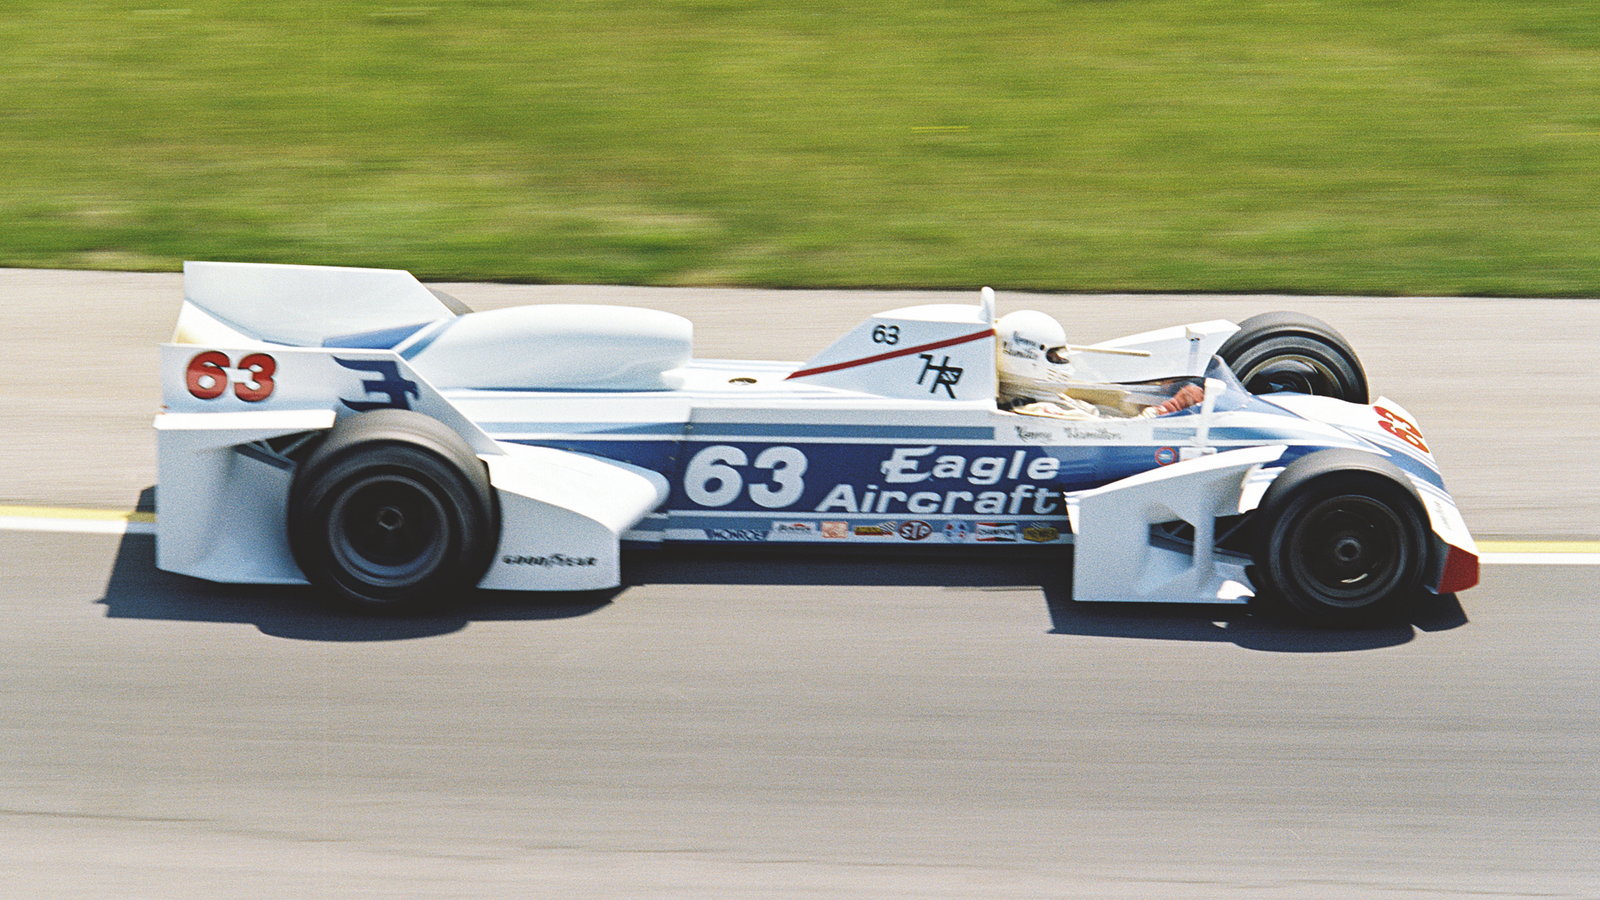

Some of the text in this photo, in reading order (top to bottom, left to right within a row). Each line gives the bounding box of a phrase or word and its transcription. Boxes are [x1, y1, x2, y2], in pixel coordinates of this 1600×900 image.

[872, 324, 899, 345] 63
[185, 350, 276, 402] 63
[1373, 405, 1431, 454] 63
[683, 445, 808, 508] 63
[880, 445, 1061, 485] Eagle
[814, 484, 1061, 514] Aircraft
[900, 522, 931, 539] STP
